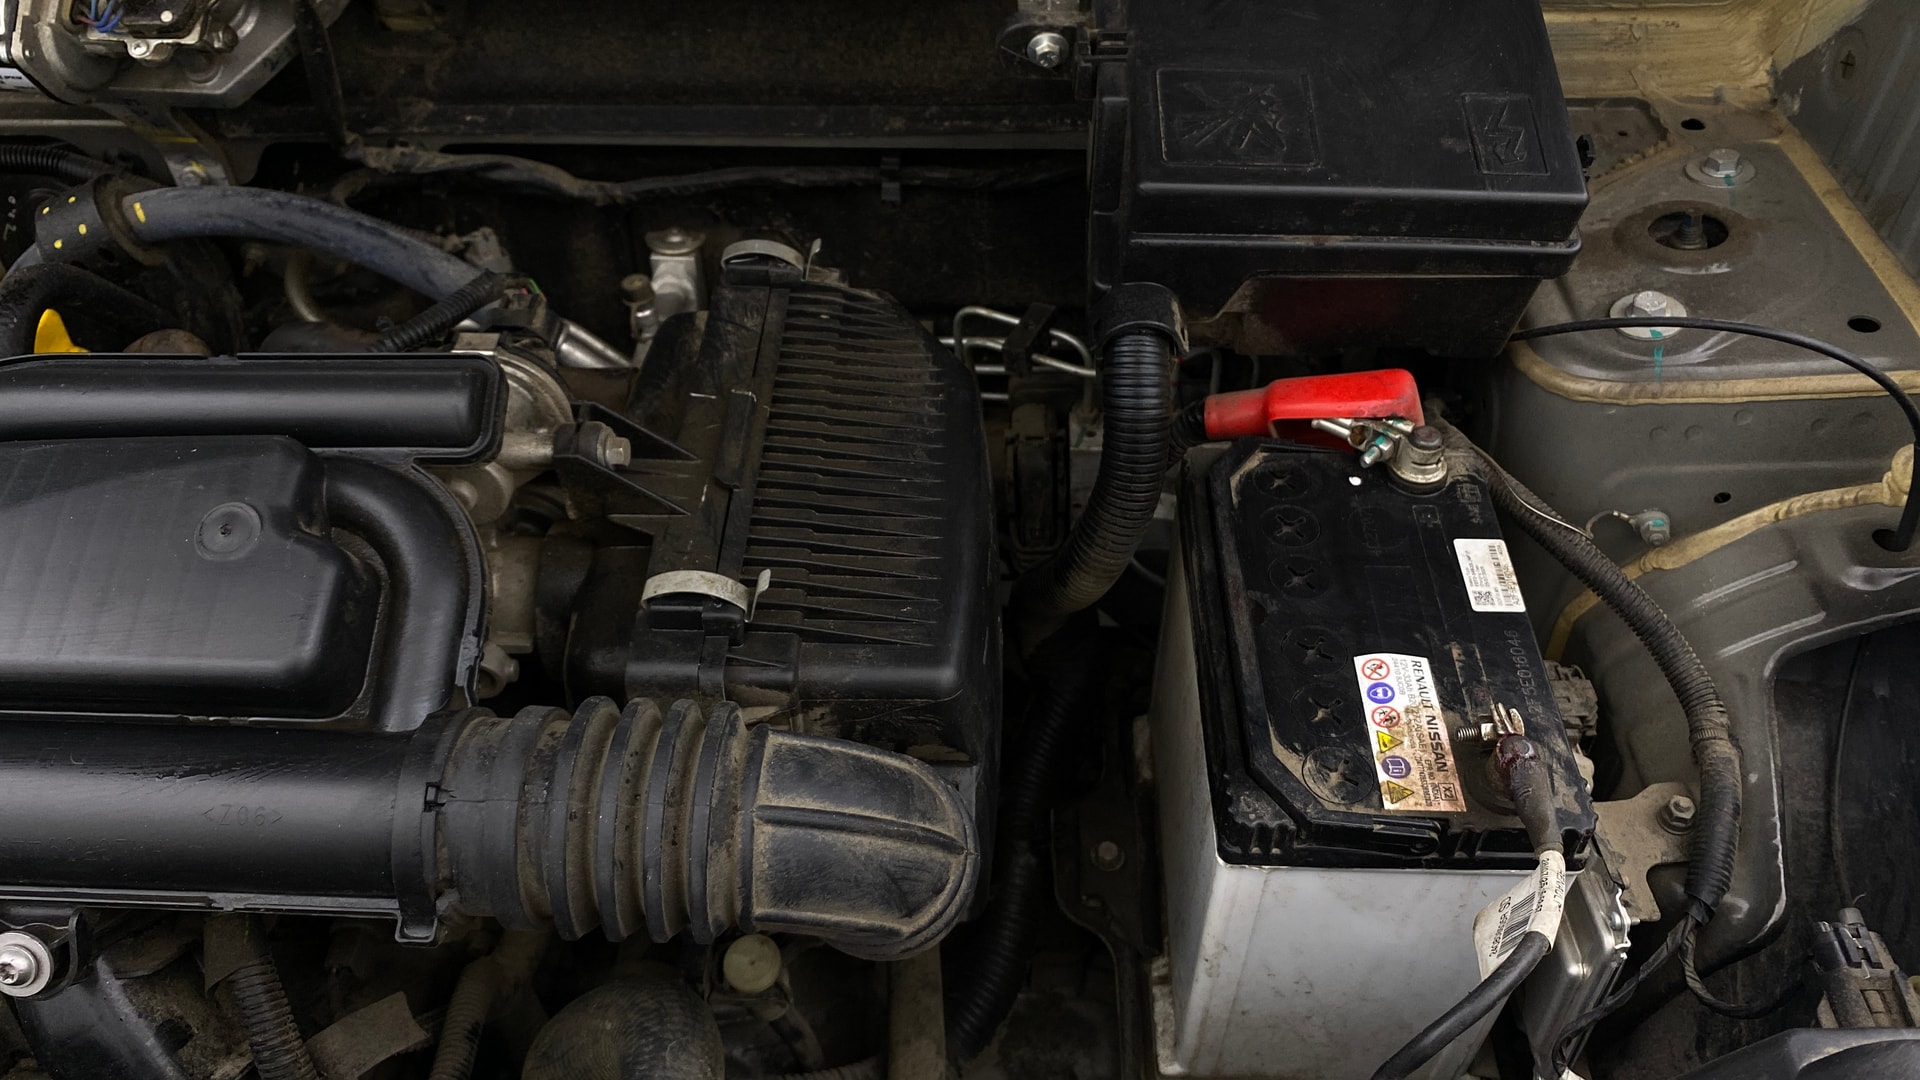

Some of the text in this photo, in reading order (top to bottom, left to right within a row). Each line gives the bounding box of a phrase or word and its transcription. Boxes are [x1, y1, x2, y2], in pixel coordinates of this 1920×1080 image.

[1411, 660, 1433, 710] RENAULT
[1425, 714, 1448, 772] NISSAN
[1443, 786, 1454, 799] X2
